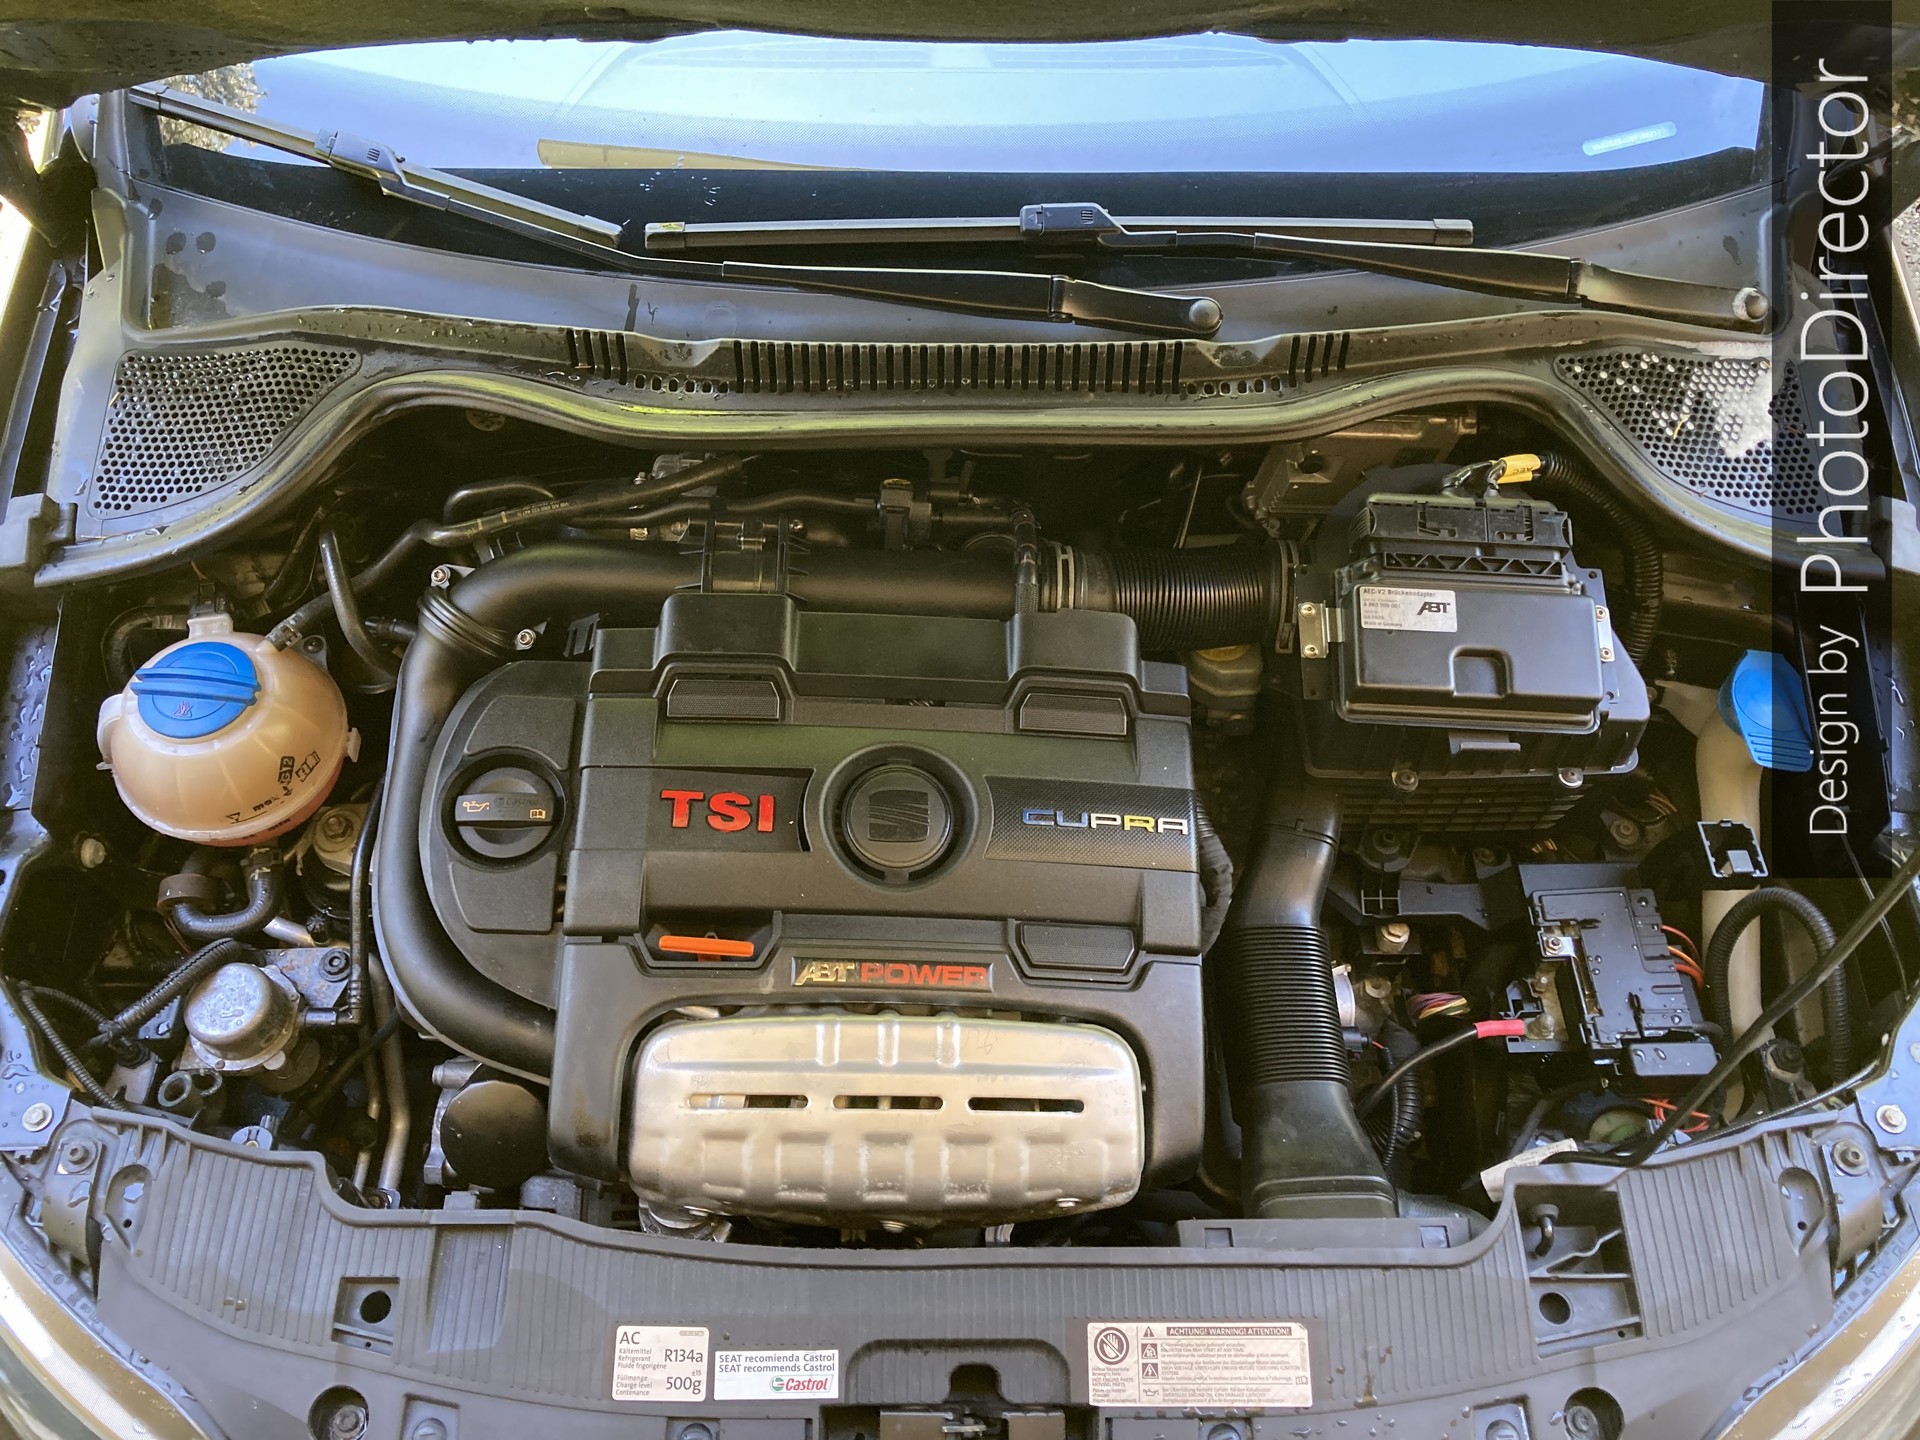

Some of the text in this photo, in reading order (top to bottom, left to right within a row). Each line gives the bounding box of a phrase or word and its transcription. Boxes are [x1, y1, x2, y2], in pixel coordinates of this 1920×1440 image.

[1416, 601, 1448, 616] ABT
[660, 789, 775, 833] TSI
[1022, 808, 1189, 835] CUPRA
[794, 961, 987, 987] ABT POWER
[619, 1331, 641, 1344] AC
[1169, 1327, 1290, 1335] ACHTUNG! WARNING! ATTENTION!
[664, 1349, 703, 1363] R134a
[719, 1353, 835, 1363] SEAT recomienda Castrol
[719, 1363, 835, 1373] SEAT recommends Castrol
[617, 1374, 648, 1382] Füllmenge
[785, 1378, 828, 1391] Castrol
[666, 1376, 701, 1395] 500g
